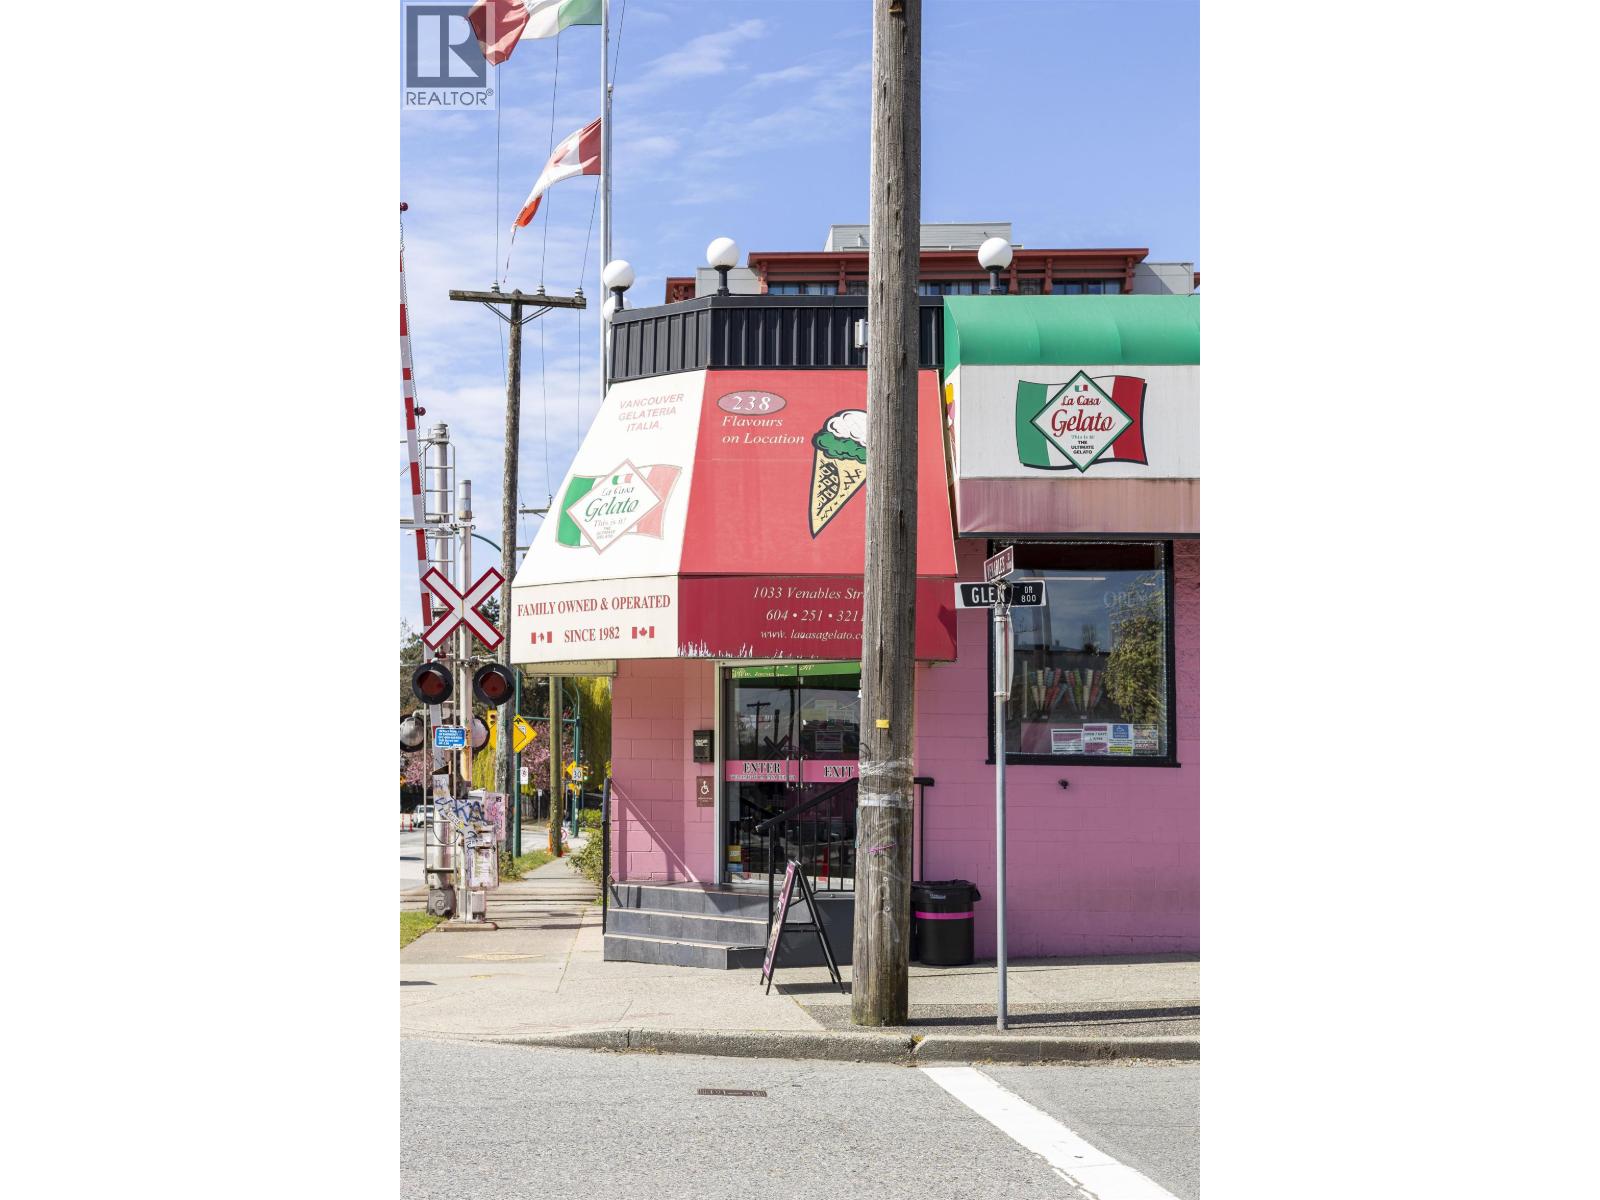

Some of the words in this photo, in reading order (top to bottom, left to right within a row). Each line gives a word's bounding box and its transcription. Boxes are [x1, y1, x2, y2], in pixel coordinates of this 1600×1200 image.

[620, 393, 684, 409] VANCOUVER
[732, 395, 772, 411] 238
[1061, 395, 1075, 406] La
[1077, 395, 1102, 406] Casa
[618, 407, 677, 422] GELATERIA
[721, 415, 784, 428] Flavours
[1051, 409, 1116, 437] Gelato
[722, 434, 740, 444] on
[744, 432, 805, 445] Location
[584, 496, 640, 523] Gelato
[753, 586, 783, 599] 1033
[787, 586, 842, 600] Venables
[844, 587, 865, 600] Str
[1024, 585, 1033, 594] DR
[1021, 594, 1037, 603] 800
[517, 602, 556, 617] FAMILY
[557, 598, 598, 615] OWNED
[600, 597, 609, 611] &
[611, 594, 671, 610] OPERATED
[766, 609, 789, 621] 604
[801, 609, 823, 622] 251
[836, 610, 865, 622] 321
[564, 628, 596, 643] SINCE
[599, 626, 620, 641] 1982
[743, 762, 781, 774] ENTER
[824, 765, 854, 778] EXIT
